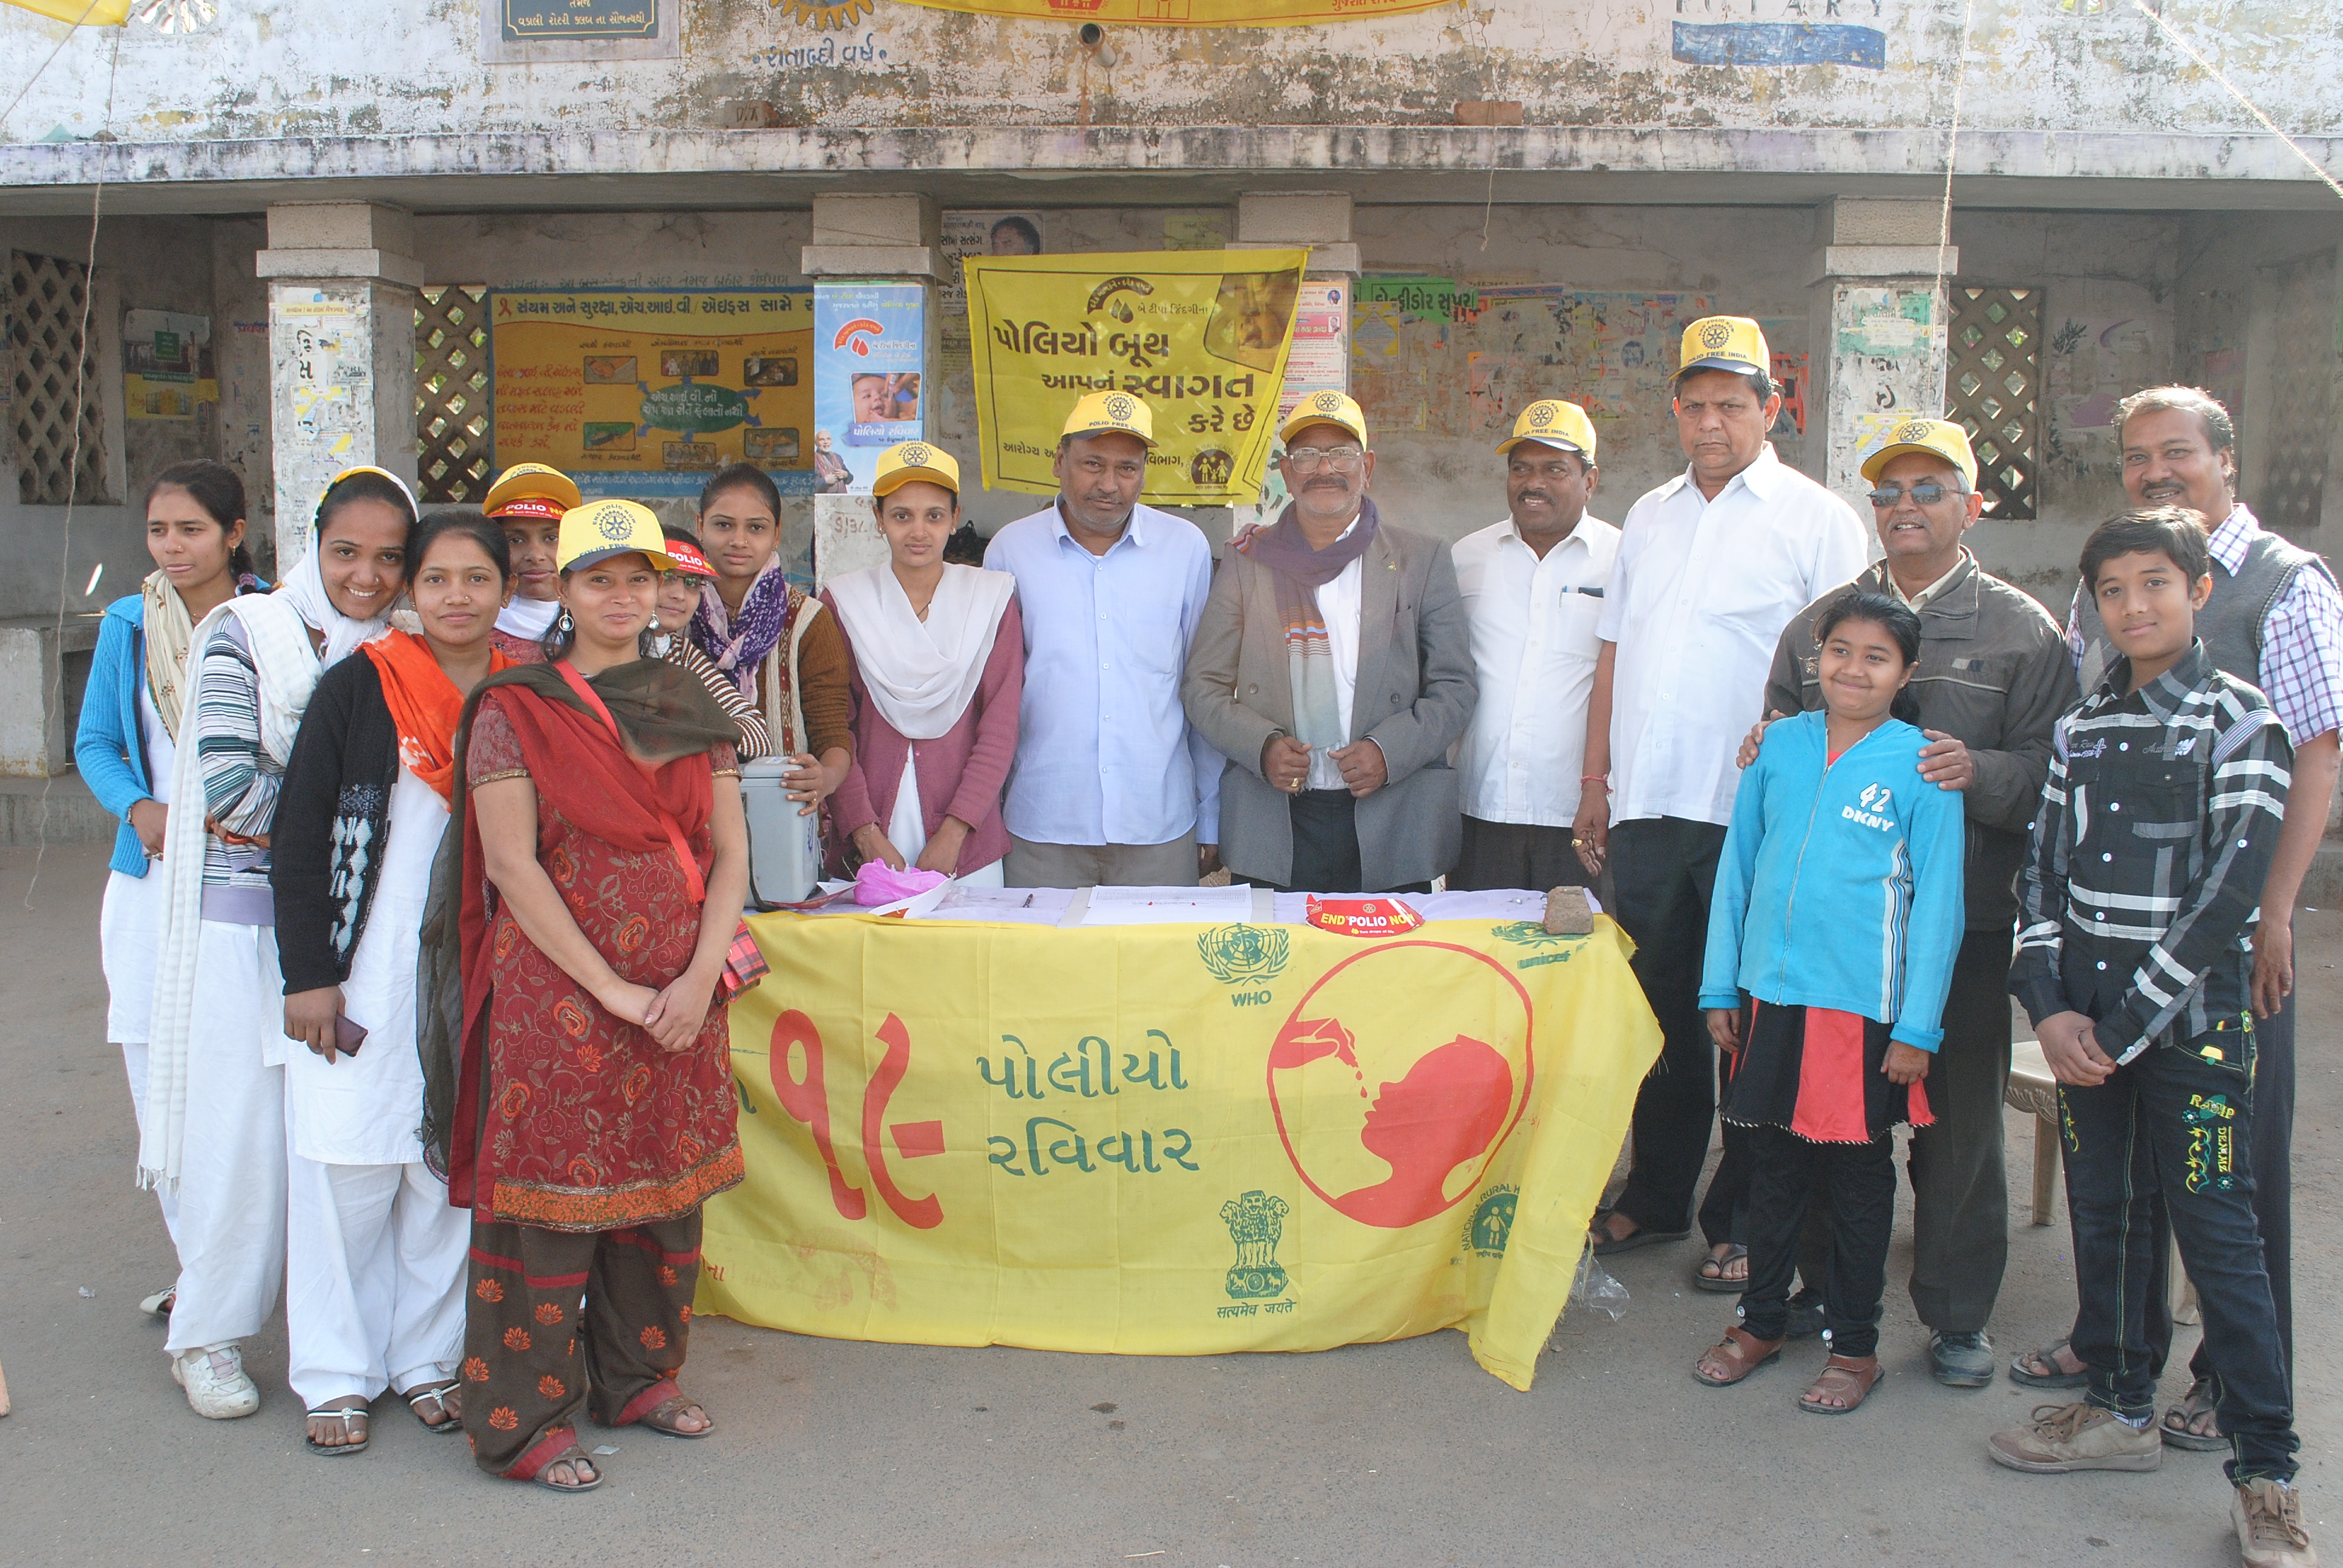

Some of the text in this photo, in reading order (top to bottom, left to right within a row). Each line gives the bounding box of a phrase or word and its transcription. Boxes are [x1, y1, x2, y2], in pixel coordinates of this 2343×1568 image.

[549, 12, 569, 25] રોટરી
[595, 15, 606, 24] ના
[842, 32, 874, 63] વર્ષ
[517, 299, 549, 315] સંયમ
[552, 297, 575, 315] અને
[760, 295, 793, 313] સામે
[1138, 302, 1146, 313] બે
[994, 319, 1170, 368] પોલિયો બૂથ
[1123, 371, 1254, 400] સ્વાગત
[1188, 403, 1256, 433] કરે છે
[854, 425, 919, 436] પોલિયો રવિવાર
[549, 507, 565, 516] NO
[592, 511, 601, 525] END
[624, 509, 637, 524] NOW
[667, 551, 703, 566] POLIO
[1841, 805, 1895, 832] DKNY
[1320, 913, 1416, 927] END POLIO NOW
[1231, 990, 1272, 1007] WHO
[975, 1028, 1190, 1100] પોલીયો
[769, 1008, 945, 1229] ૧૯
[987, 1116, 1201, 1178] રવિવાર
[1480, 1183, 1512, 1202] RURAL
[1216, 1298, 1297, 1319] सत्यमेव जयते
